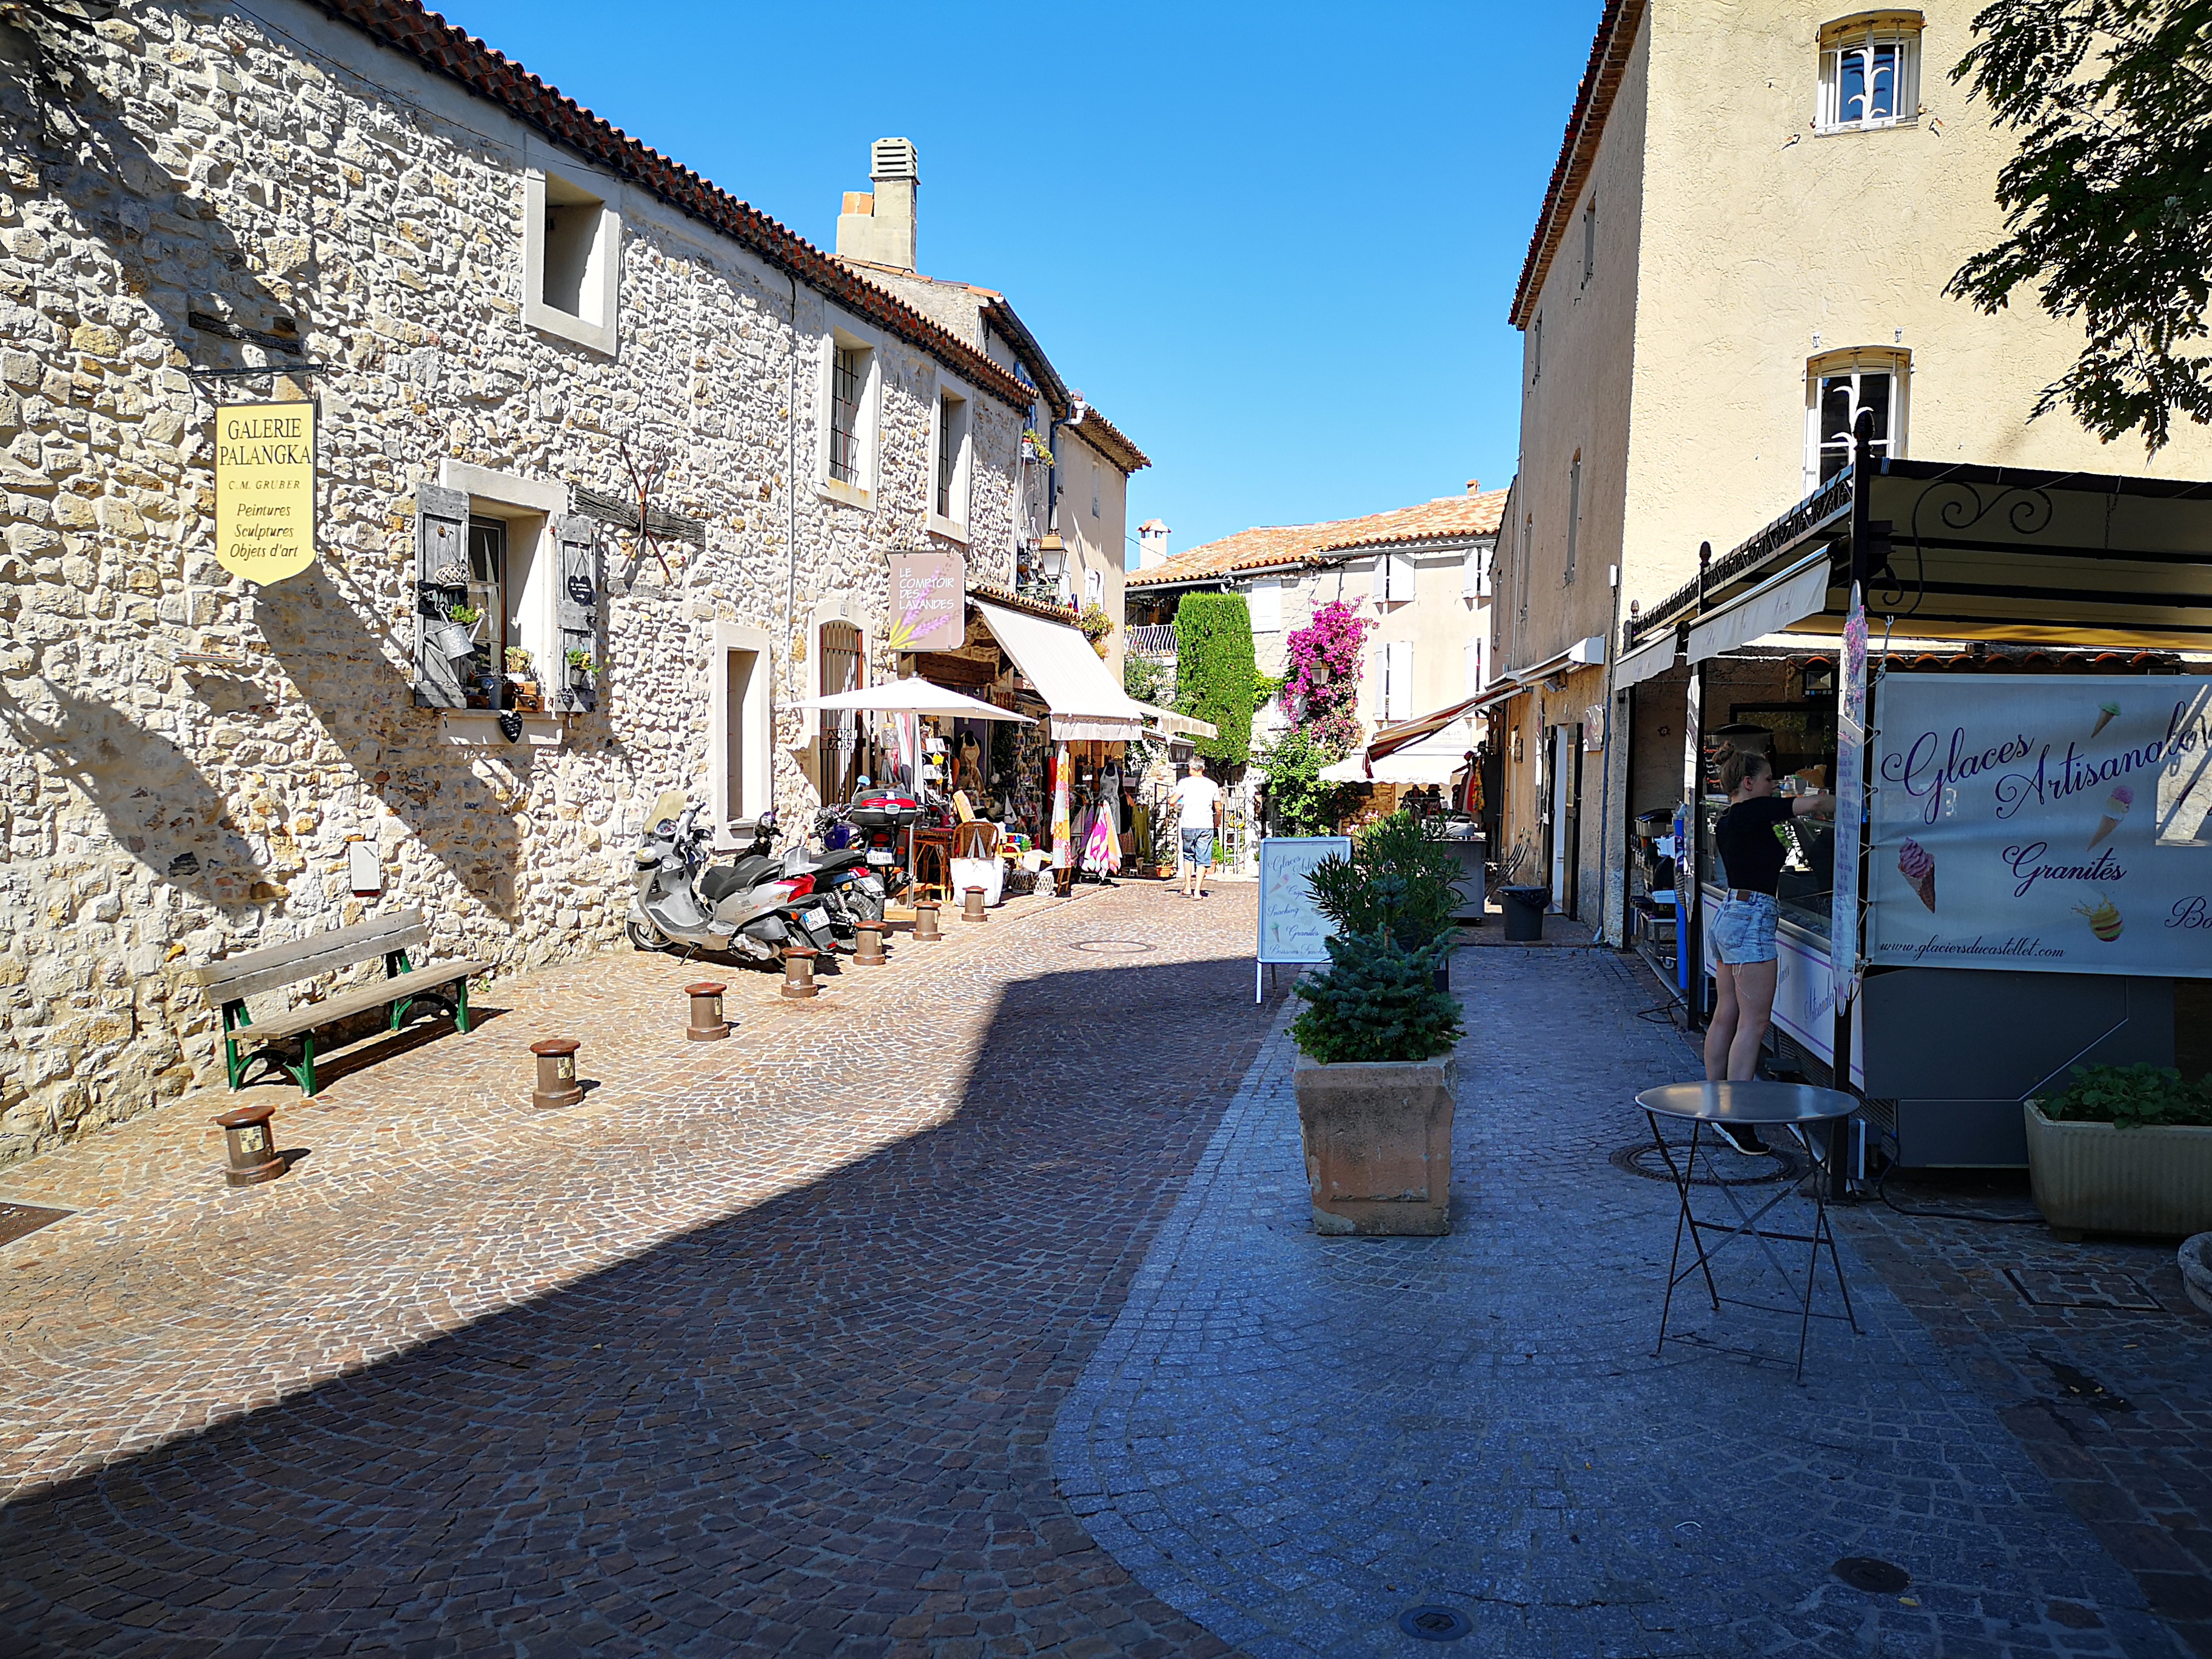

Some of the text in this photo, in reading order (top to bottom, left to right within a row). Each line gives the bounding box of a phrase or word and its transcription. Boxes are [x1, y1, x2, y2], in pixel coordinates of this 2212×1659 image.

[228, 418, 303, 440] GALERIE
[220, 444, 313, 466] PALANGKA
[256, 480, 300, 490] GRUBER
[236, 503, 291, 517] Peintures
[235, 523, 294, 541] Sculptures
[230, 543, 299, 561] Objets d'art
[899, 568, 911, 578] LE
[899, 577, 954, 589] COMPTOIR
[899, 589, 920, 600] DES
[899, 598, 954, 610] LAVANDES
[1881, 727, 2035, 825] Glaces
[1268, 855, 1301, 878] Glaces
[2002, 842, 2128, 897] Granités
[1267, 903, 1299, 919] Snacking
[1268, 944, 1299, 954] Boissons
[1880, 934, 2066, 962] www.glaciersducastellet.com
